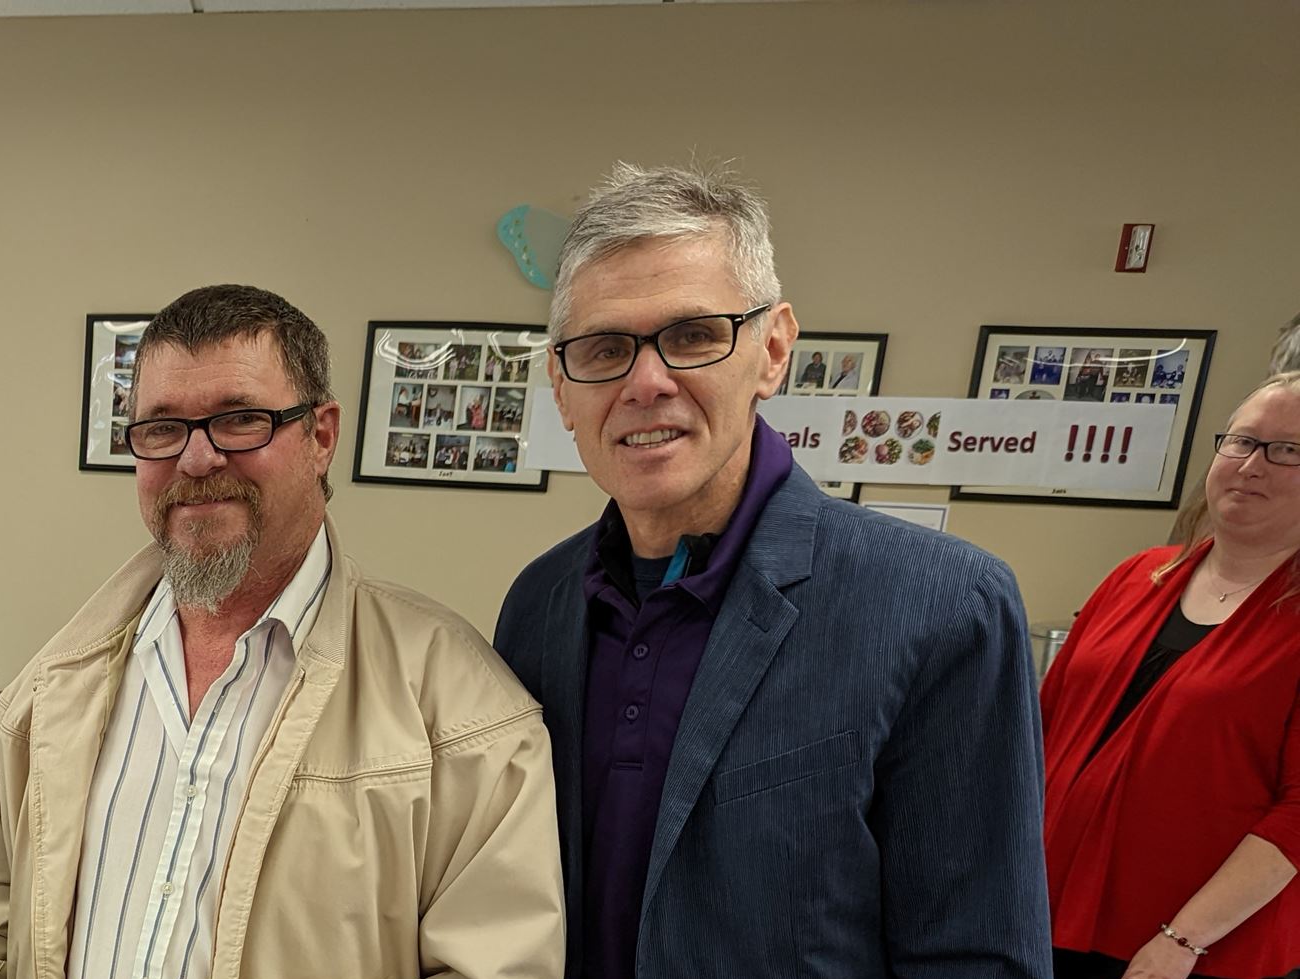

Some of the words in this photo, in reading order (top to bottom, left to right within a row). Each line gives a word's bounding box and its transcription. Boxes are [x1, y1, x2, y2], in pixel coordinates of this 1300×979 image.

[779, 426, 821, 449] als
[947, 430, 1038, 454] Served
[1063, 423, 1133, 464] !!!!
